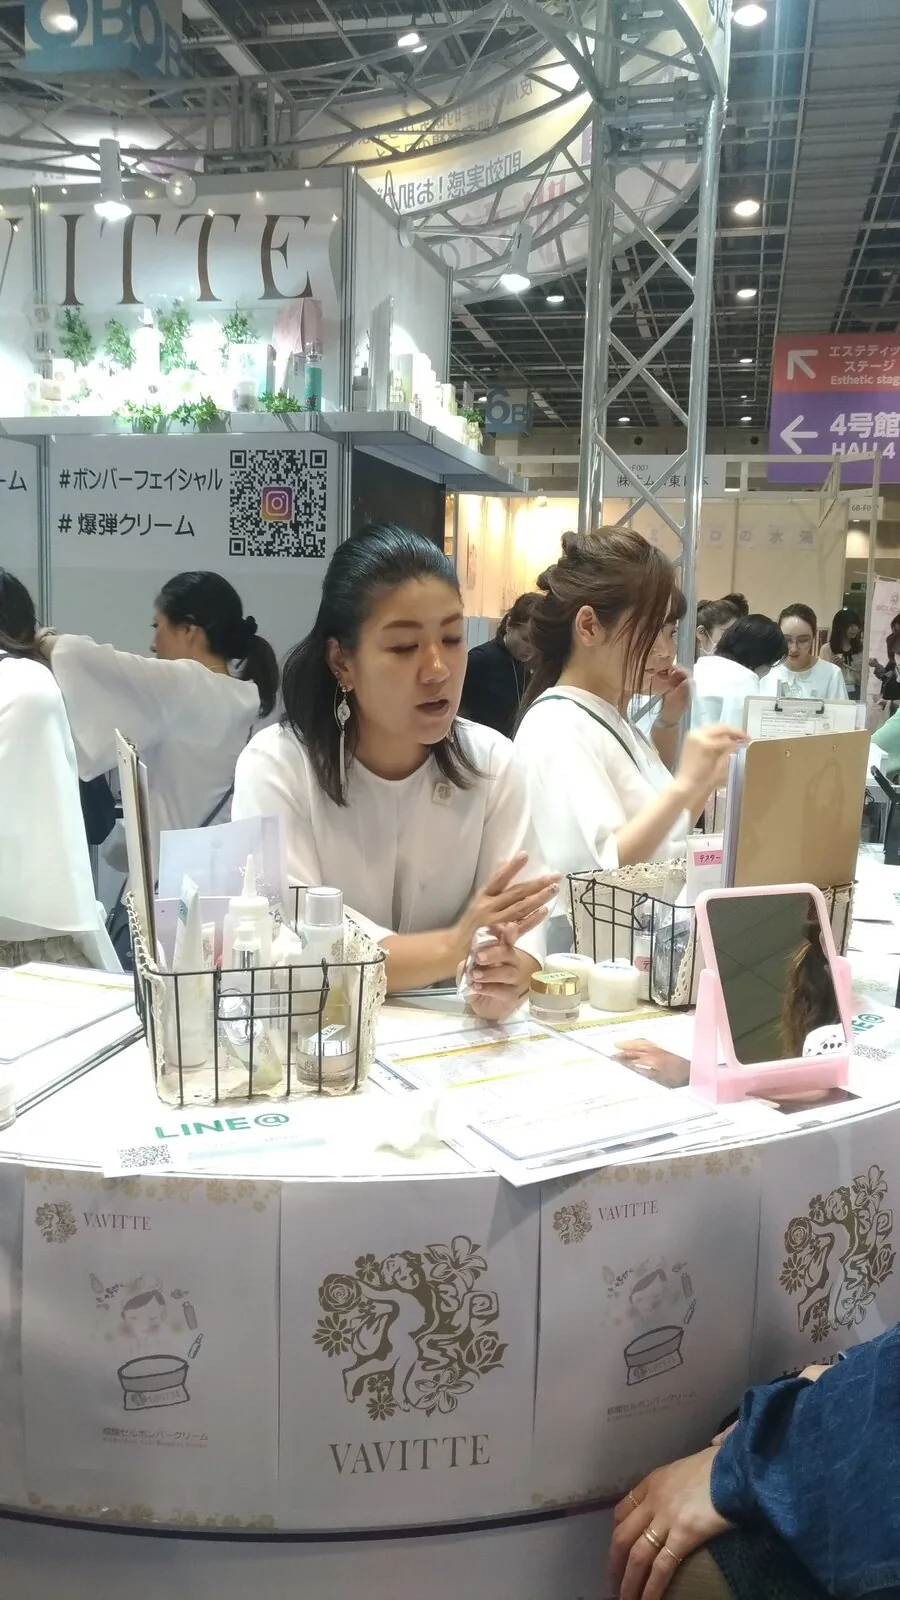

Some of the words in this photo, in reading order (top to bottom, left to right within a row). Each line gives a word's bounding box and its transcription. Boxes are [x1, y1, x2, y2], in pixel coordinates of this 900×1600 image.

[844, 358, 896, 373] ステージ
[830, 375, 874, 385] Esthetic
[829, 411, 900, 439] 4号館
[882, 442, 896, 459] 4
[58, 467, 223, 491] #ボンバーフェイシャル
[699, 854, 721, 864] テスター
[155, 1113, 290, 1139] LINE@
[597, 1199, 659, 1221] VAVITTE
[83, 1211, 152, 1231] VAVITTE
[328, 1434, 490, 1475] VAVITTE
